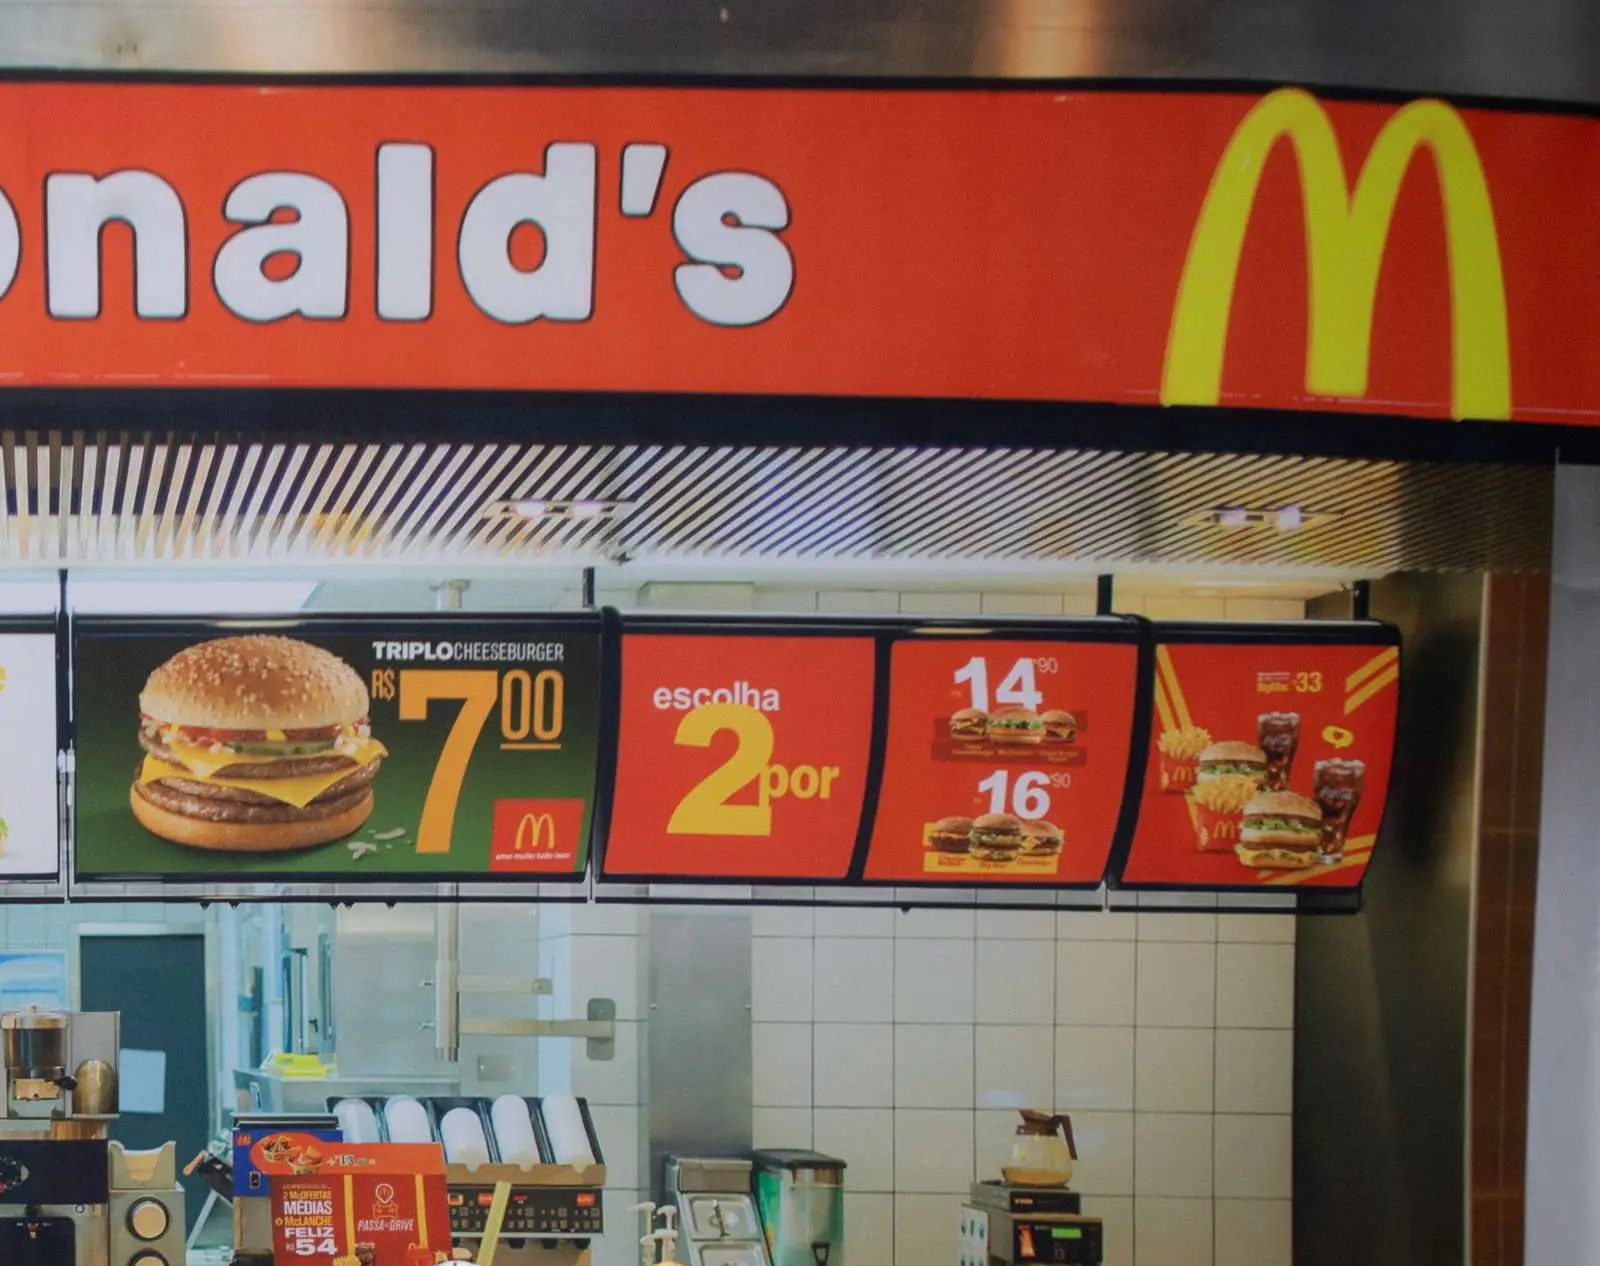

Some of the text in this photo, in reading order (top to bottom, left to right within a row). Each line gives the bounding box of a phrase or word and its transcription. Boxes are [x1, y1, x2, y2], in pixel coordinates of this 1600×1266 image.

[953, 655, 1044, 712] 14
[1295, 671, 1323, 693] 33
[652, 681, 781, 712] escolha
[371, 668, 564, 853] R$ 7 00
[665, 702, 840, 837] 2 por
[977, 769, 1051, 821] 16
[284, 1198, 333, 1215] MÉDIAS
[284, 1216, 332, 1226] McLANCHE
[357, 1218, 415, 1232] PASSA DRIVE
[285, 1227, 335, 1239] FELIZ
[295, 1238, 338, 1256] 54
